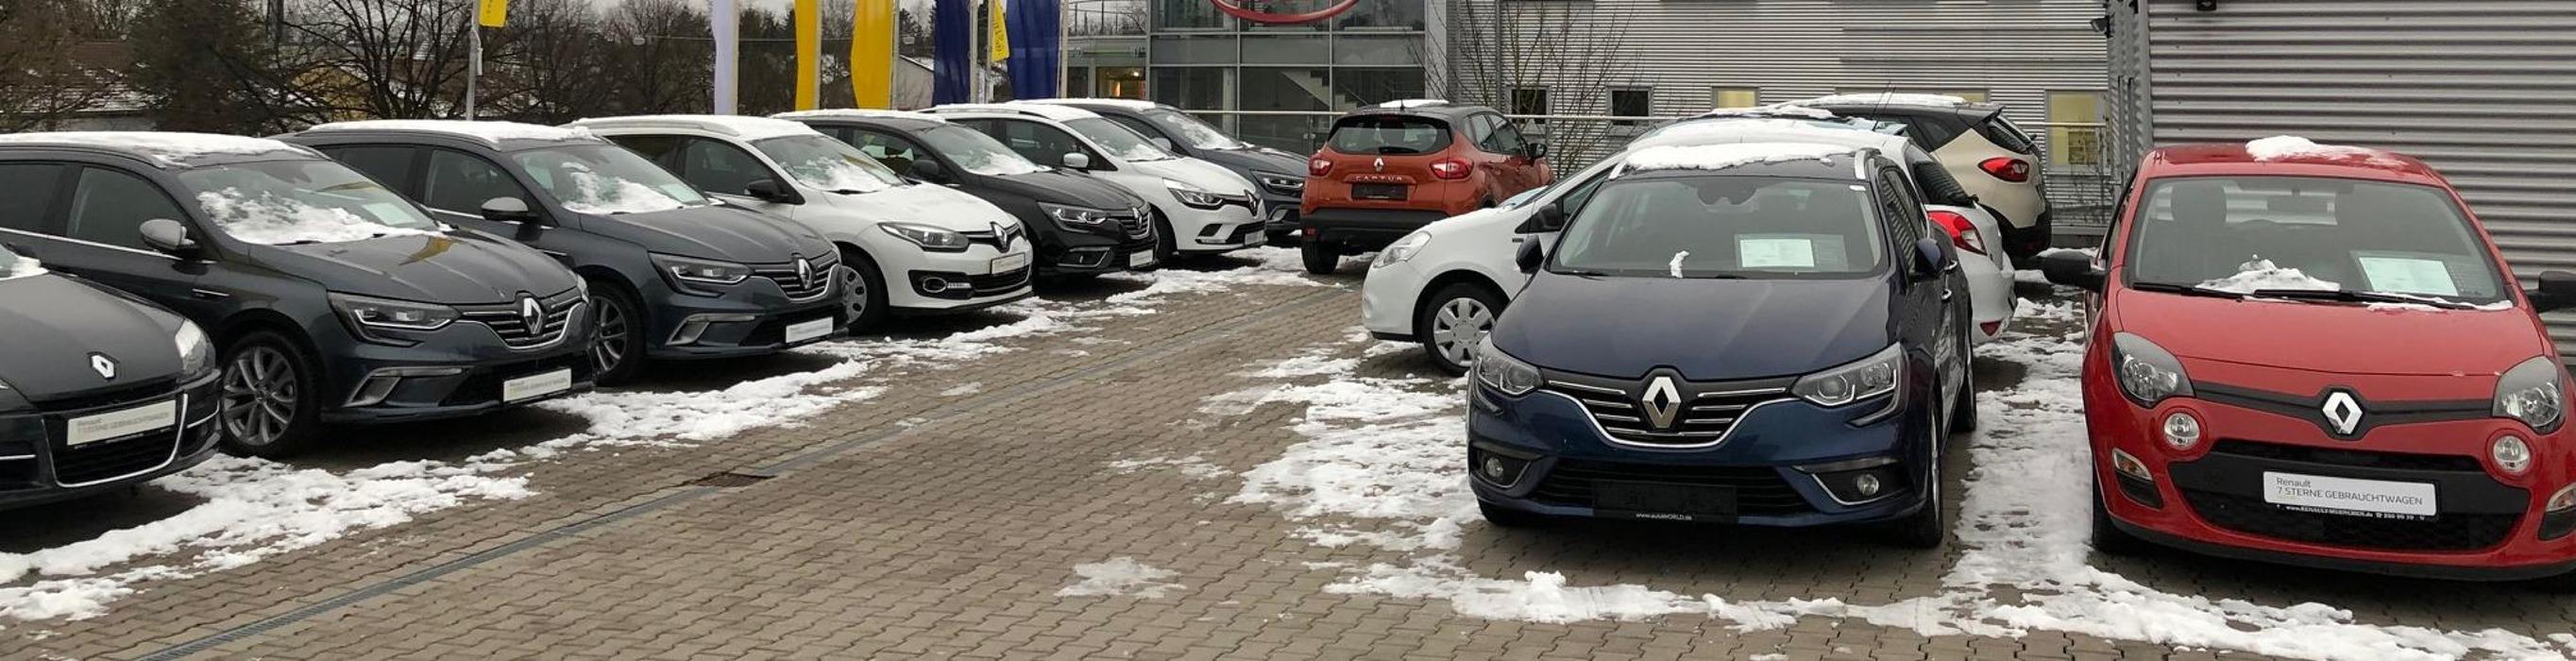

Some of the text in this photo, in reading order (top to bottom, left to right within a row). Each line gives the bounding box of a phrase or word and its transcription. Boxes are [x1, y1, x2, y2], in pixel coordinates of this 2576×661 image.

[2276, 477, 2311, 488] Renault
[2285, 486, 2323, 499] STERNE
[2325, 490, 2423, 505] GEBRAUCHTWAGEN
